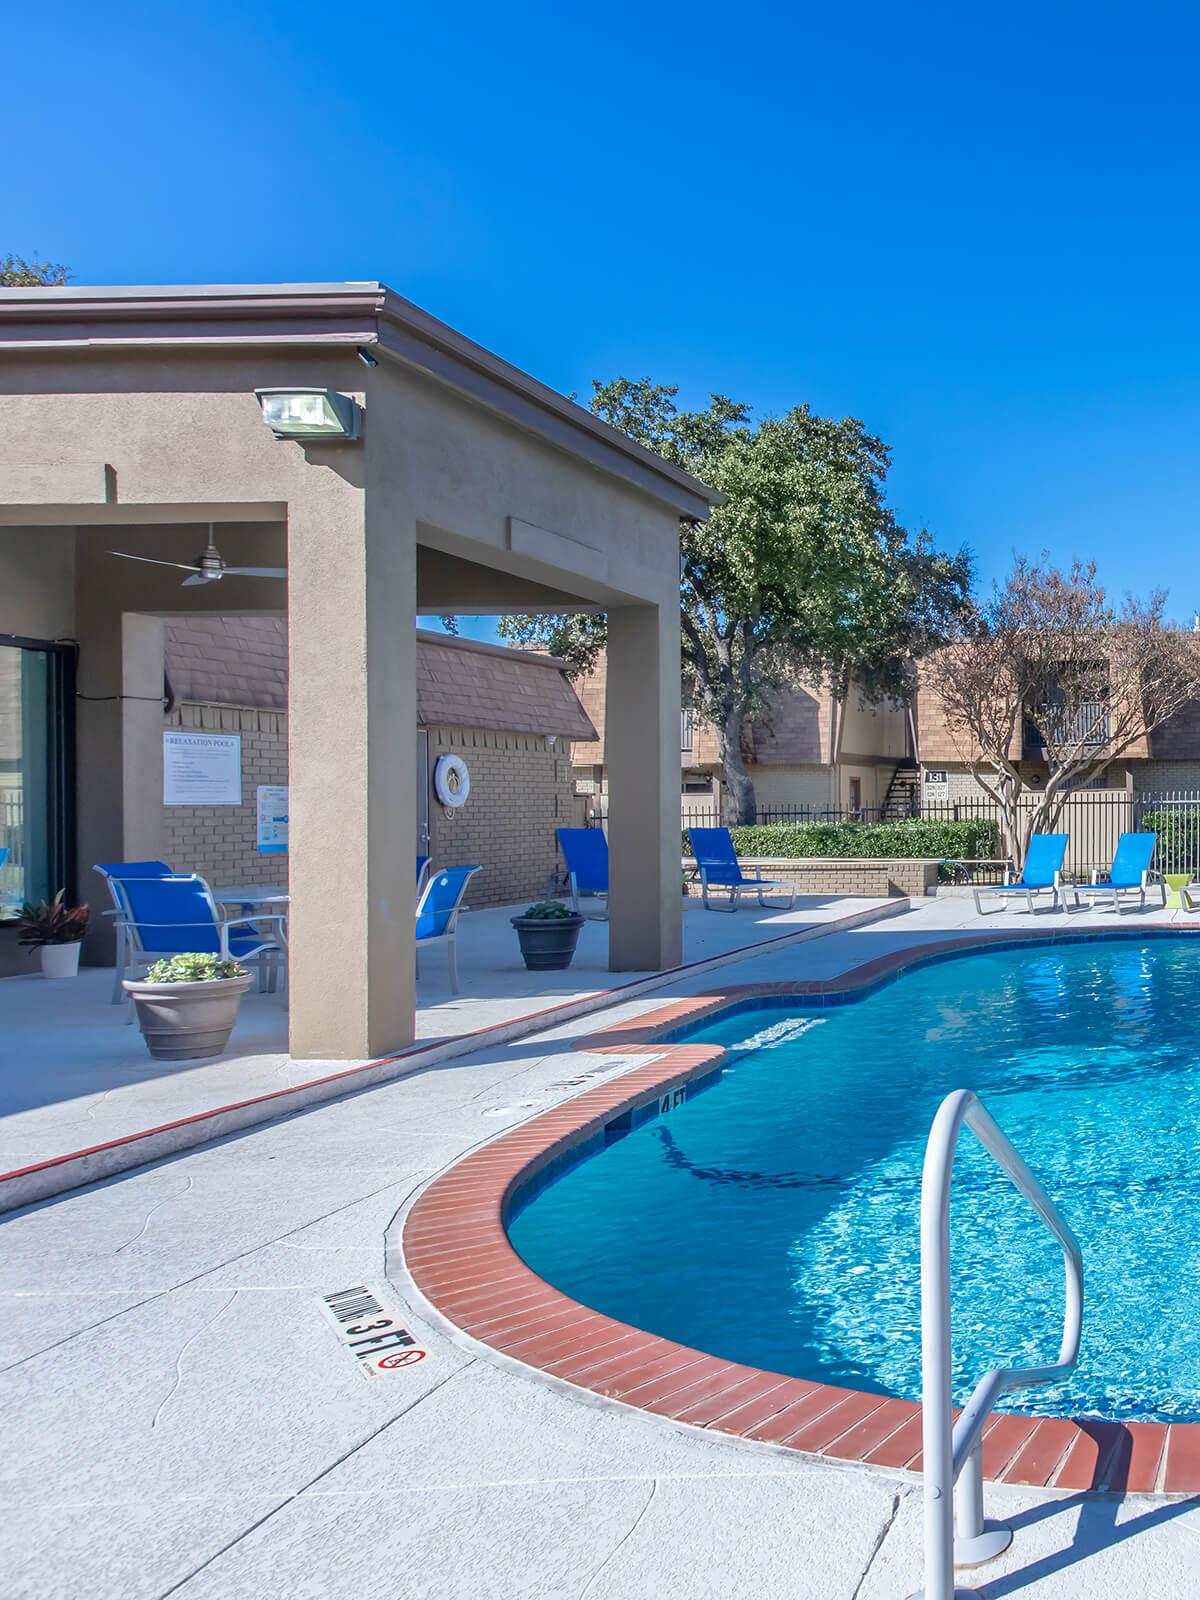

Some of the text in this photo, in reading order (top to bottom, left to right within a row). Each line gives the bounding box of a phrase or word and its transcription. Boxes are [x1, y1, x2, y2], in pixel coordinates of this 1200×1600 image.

[929, 772, 942, 782] 131
[661, 1087, 685, 1113] 4 FT
[322, 1285, 369, 1303] NO
[329, 1294, 385, 1323] DIVING
[346, 1319, 394, 1335] 3
